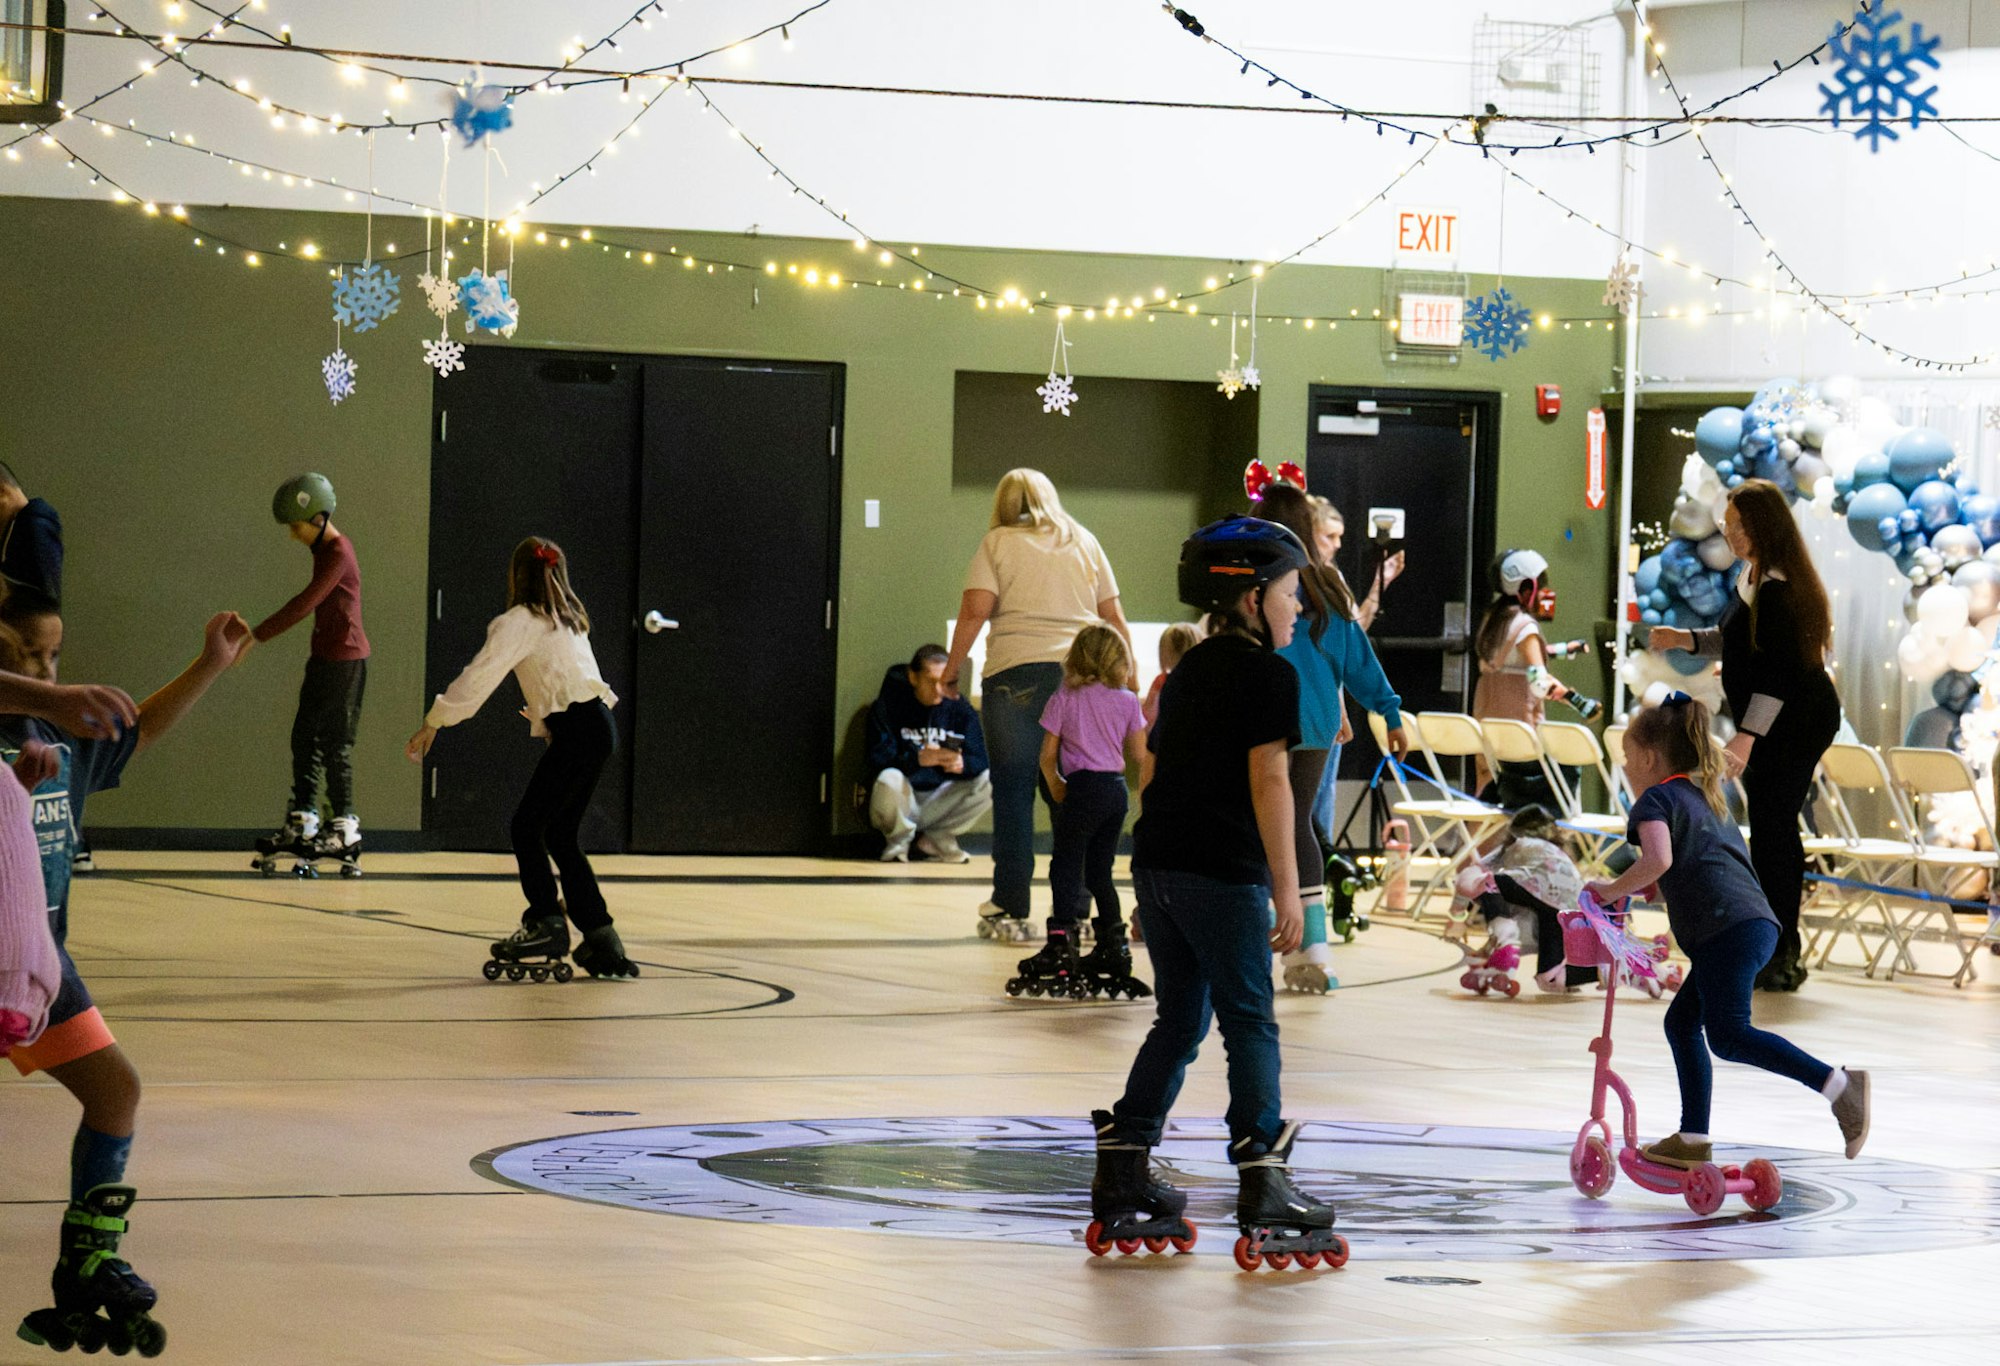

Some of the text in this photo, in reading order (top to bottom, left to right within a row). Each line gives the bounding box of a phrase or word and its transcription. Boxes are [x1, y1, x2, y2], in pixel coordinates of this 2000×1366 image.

[1399, 212, 1457, 253] EXIT
[1413, 302, 1455, 338] EXIT
[35, 799, 69, 825] ANS
